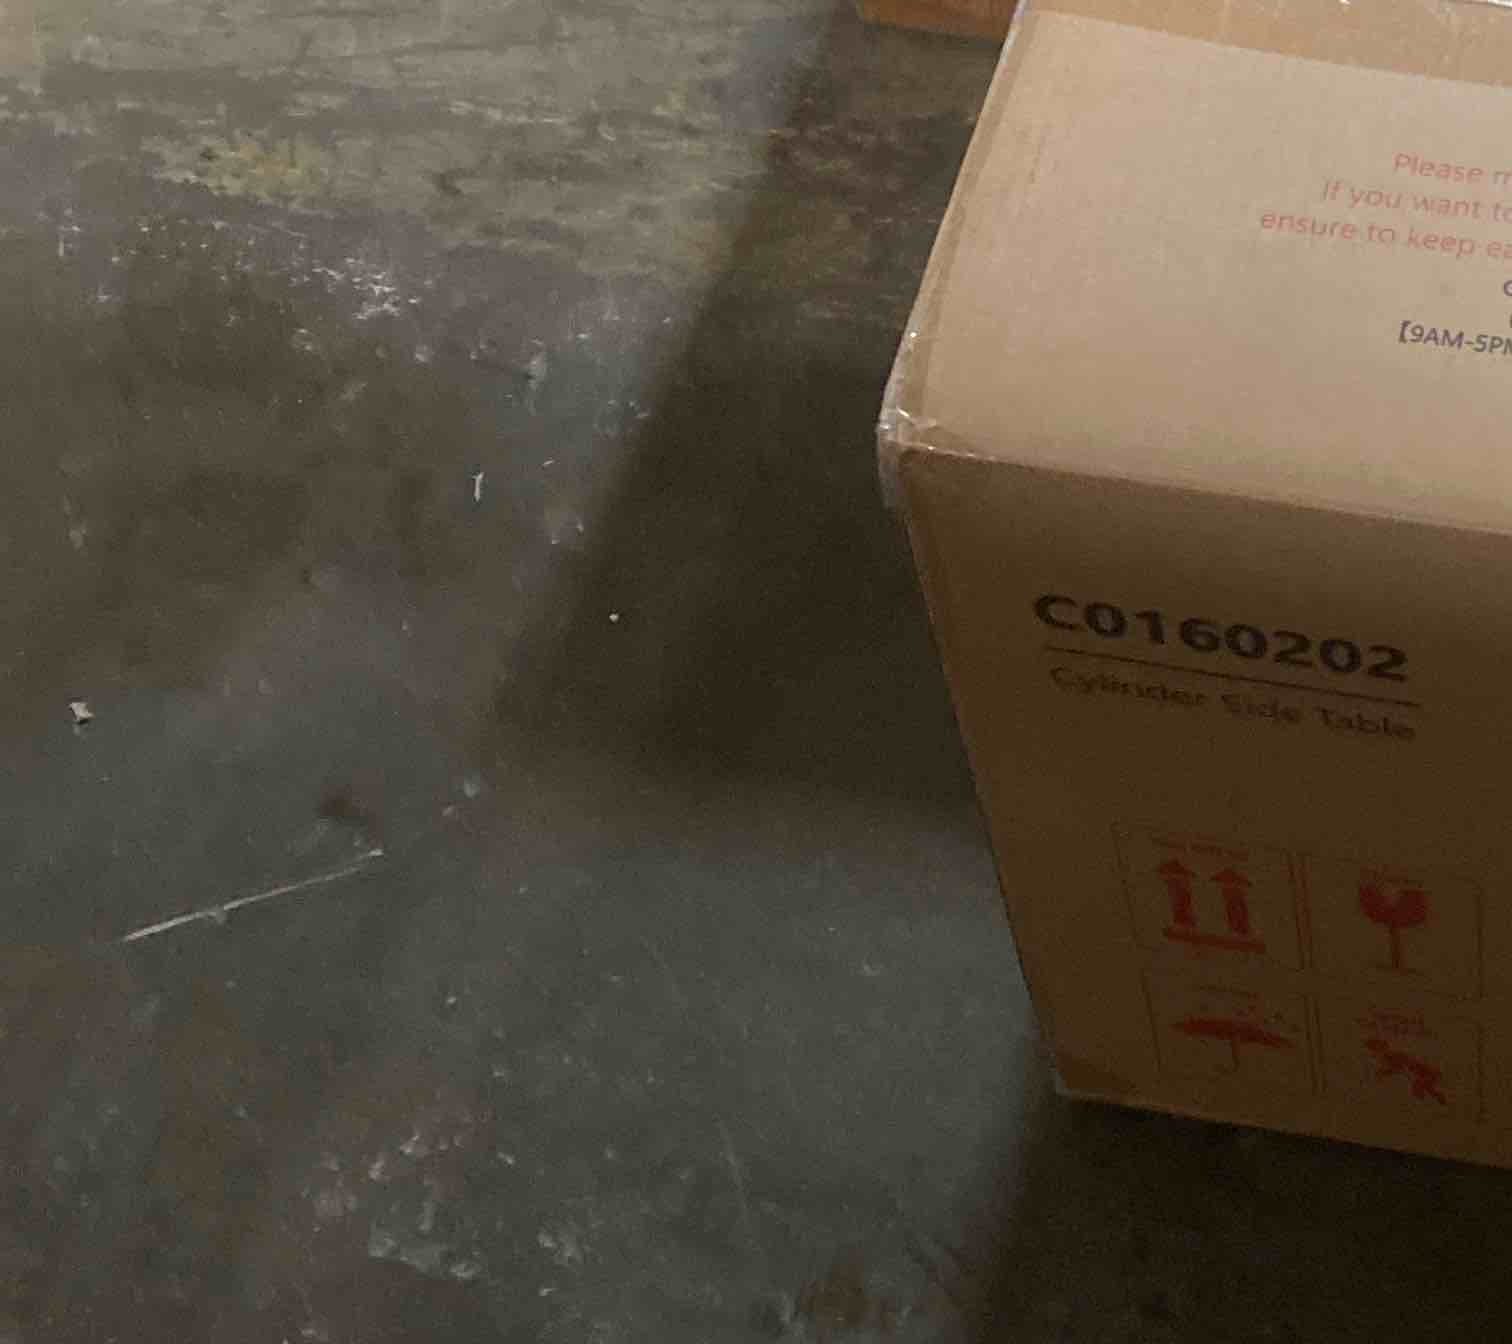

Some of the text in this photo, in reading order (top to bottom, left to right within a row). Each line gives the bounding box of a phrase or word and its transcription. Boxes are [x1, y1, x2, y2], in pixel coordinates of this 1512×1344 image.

[1393, 153, 1483, 183] Please
[1321, 179, 1345, 201] If
[1348, 187, 1401, 209] you
[1412, 192, 1482, 218] want
[1261, 212, 1358, 240] ensure
[1367, 223, 1396, 246] to
[1406, 227, 1475, 259] keep
[1033, 593, 1409, 682] C0160202
[1049, 665, 1415, 740] Cylinder Side Table
